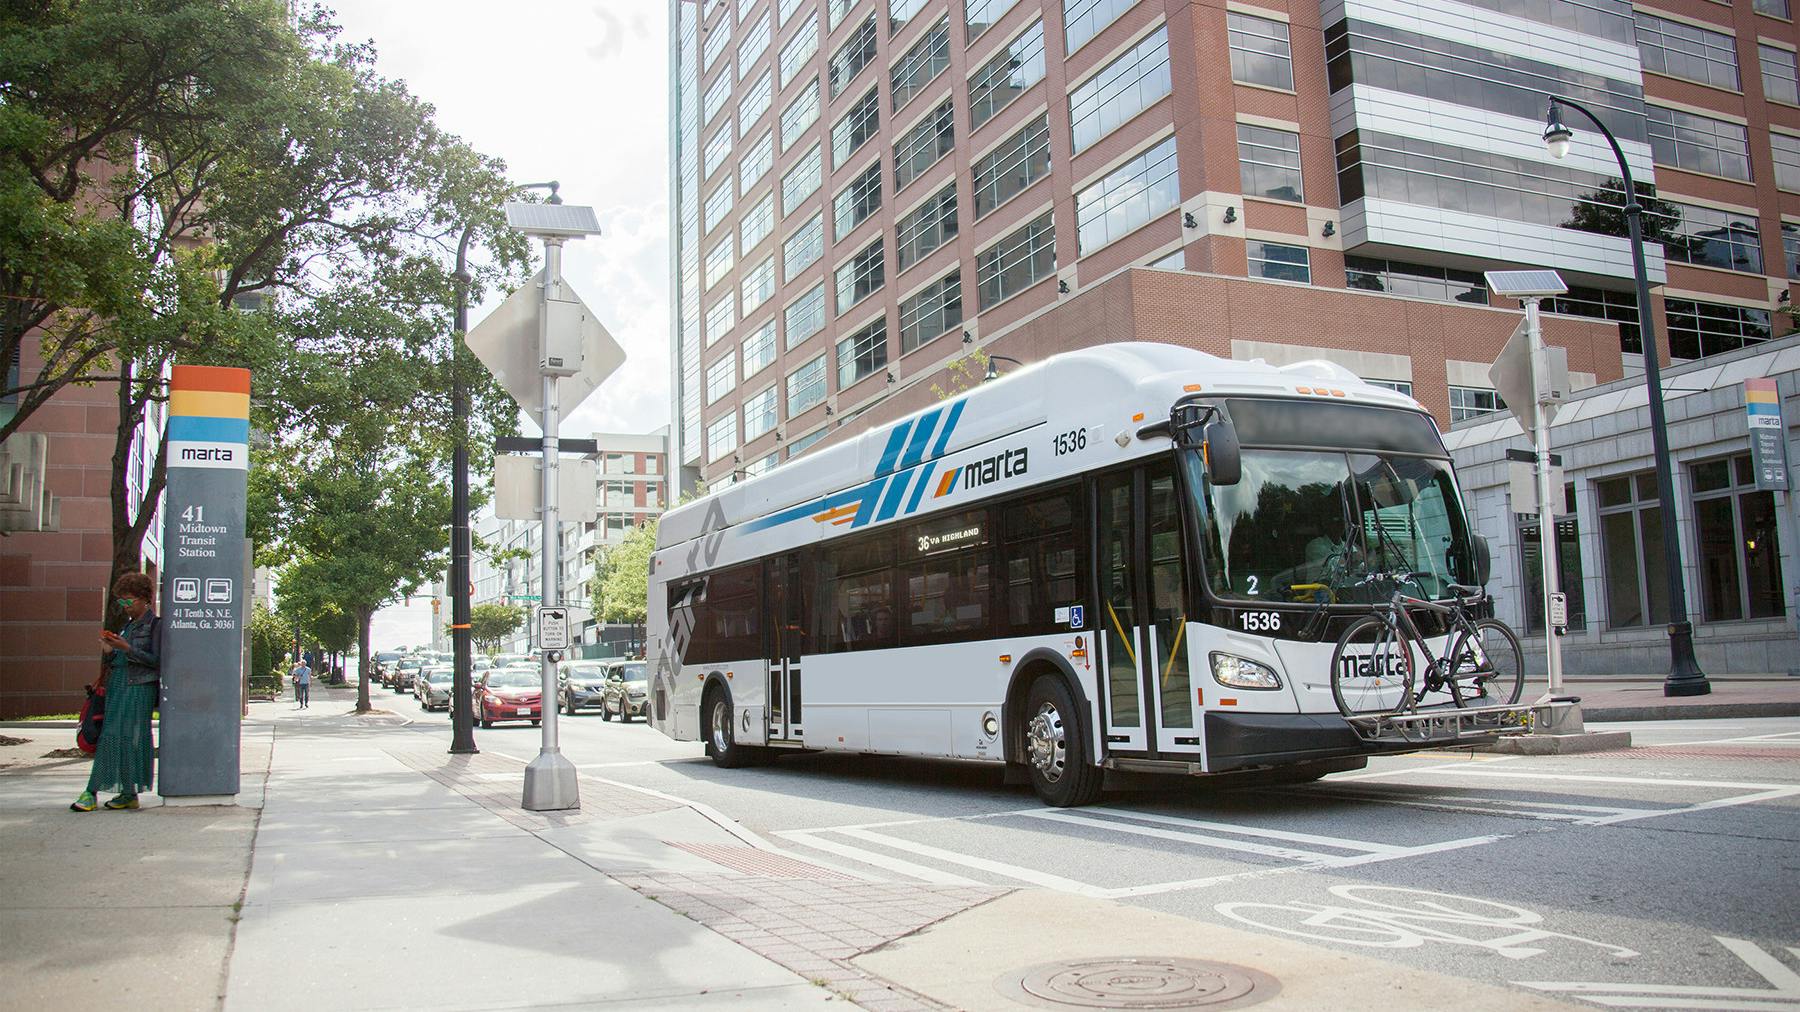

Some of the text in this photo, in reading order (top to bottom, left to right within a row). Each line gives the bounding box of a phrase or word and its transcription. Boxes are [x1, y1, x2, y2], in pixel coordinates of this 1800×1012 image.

[1758, 417, 1780, 426] marta
[1053, 427, 1087, 457] 1536
[182, 448, 233, 461] marta
[964, 447, 1028, 490] marta
[181, 505, 204, 522] 41
[179, 523, 227, 534] Midtown
[179, 535, 216, 546] Transit
[918, 527, 979, 552] 36 VA HIGHLAND
[179, 547, 216, 558] Station
[1246, 575, 1259, 595] 2
[173, 608, 233, 618] 41 Tenth St. N.E.
[170, 620, 235, 630] Atlanta, Ga. 30361
[1240, 612, 1281, 631] 1536
[1337, 654, 1409, 678] marta
